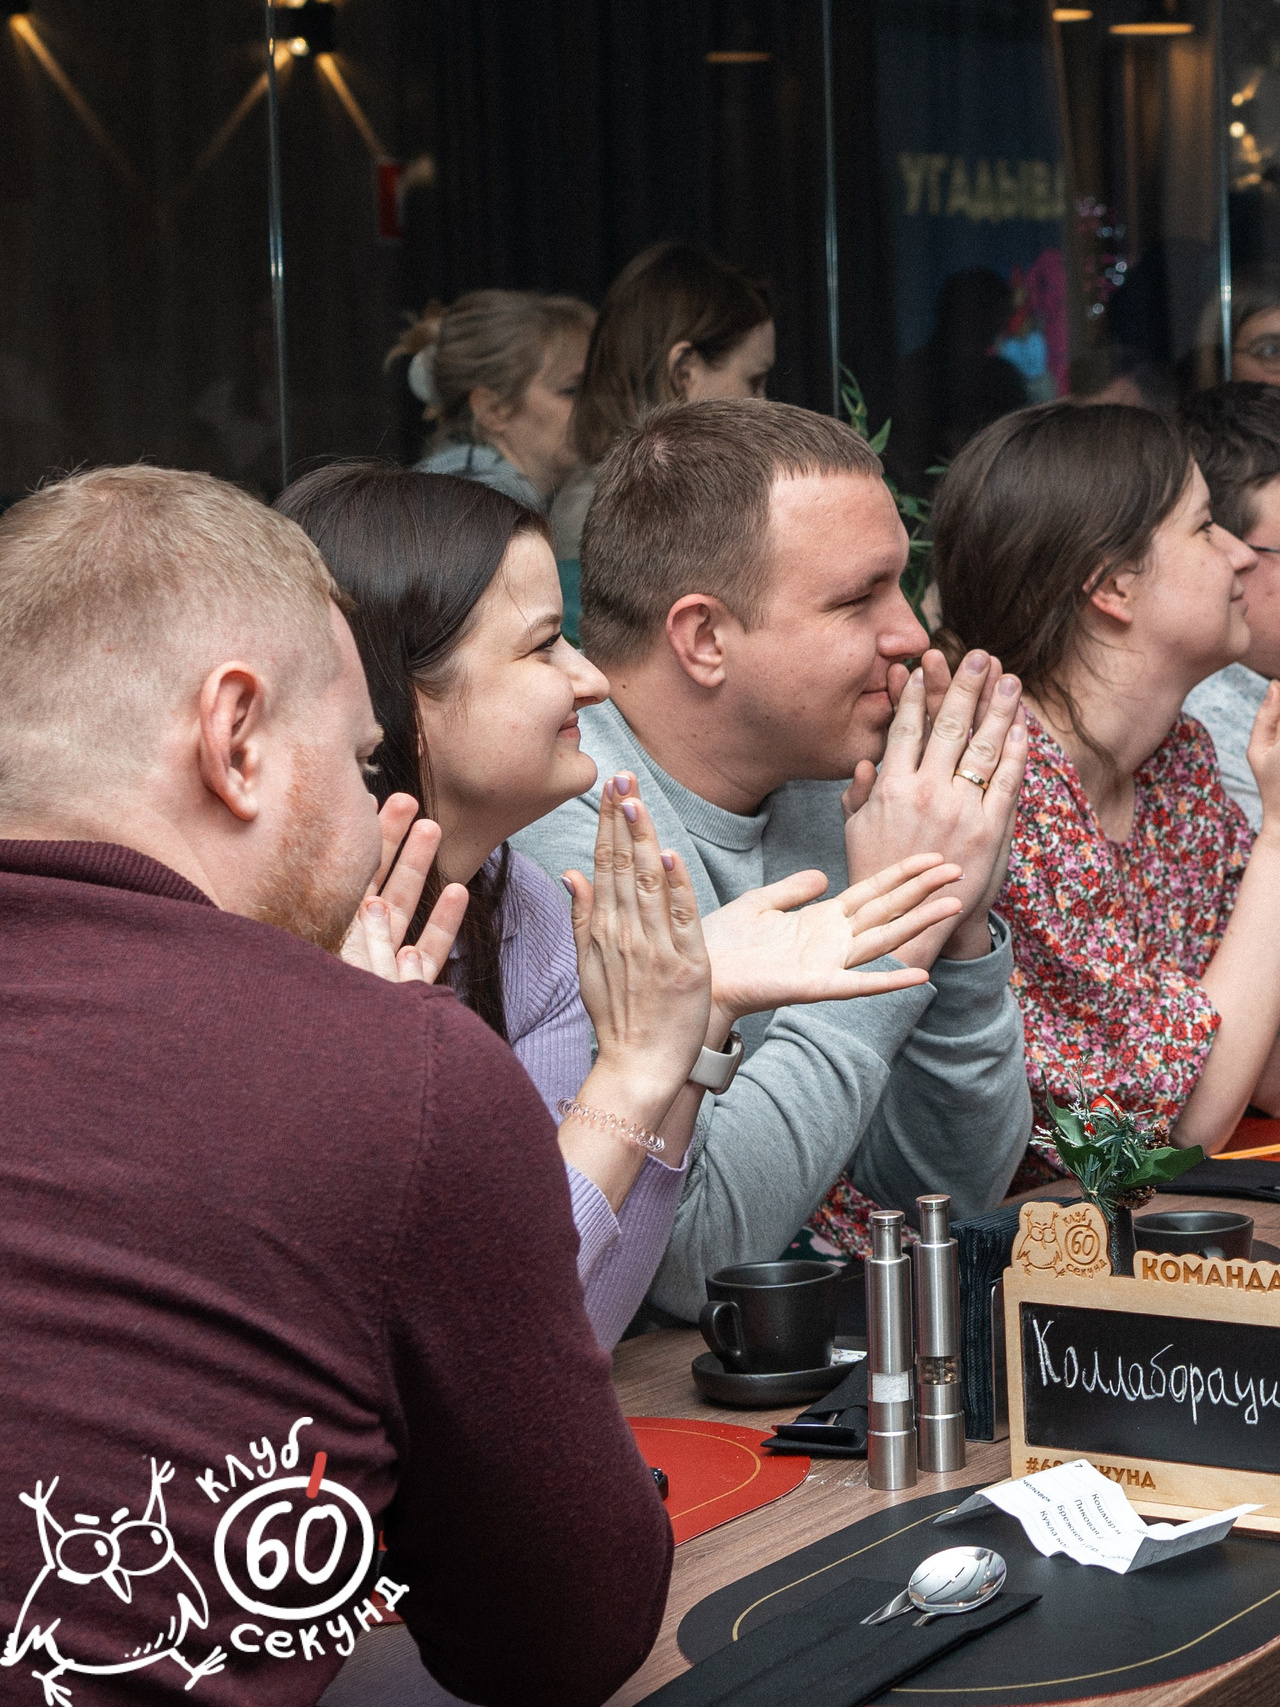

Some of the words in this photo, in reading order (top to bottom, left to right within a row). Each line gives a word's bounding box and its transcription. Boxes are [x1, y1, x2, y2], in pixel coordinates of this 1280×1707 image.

[1072, 1230, 1095, 1256] 60
[1040, 1510, 1058, 1537] Кукла
[1057, 1504, 1084, 1542] Брежнев
[1074, 1499, 1100, 1535] Пиковая
[1091, 1493, 1116, 1529] Кошмар
